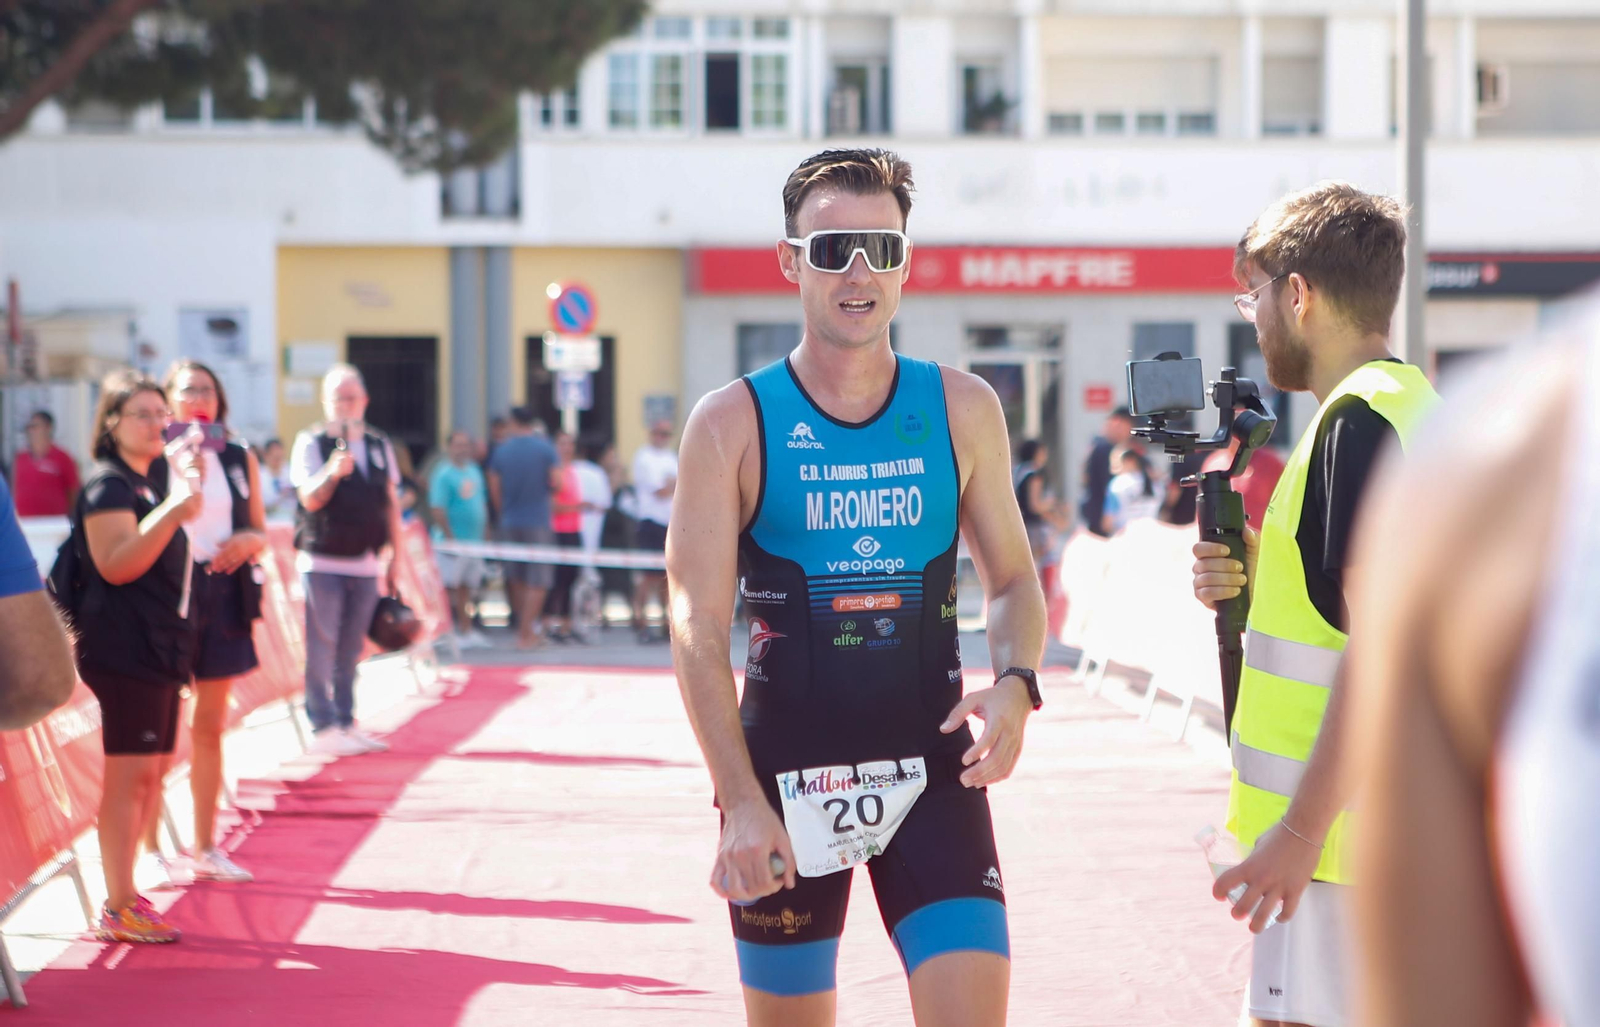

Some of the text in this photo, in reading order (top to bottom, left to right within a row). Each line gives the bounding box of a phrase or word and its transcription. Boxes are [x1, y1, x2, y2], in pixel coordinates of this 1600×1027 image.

[960, 254, 1136, 287] MAPFRE
[787, 440, 825, 450] austral
[800, 458, 925, 481] C.D. LAURUS TRIATLON
[806, 485, 923, 531] M.ROMERO
[826, 558, 905, 576] veopago
[833, 633, 864, 646] alfer
[866, 639, 893, 647] GRUPO
[823, 794, 884, 835] 20
